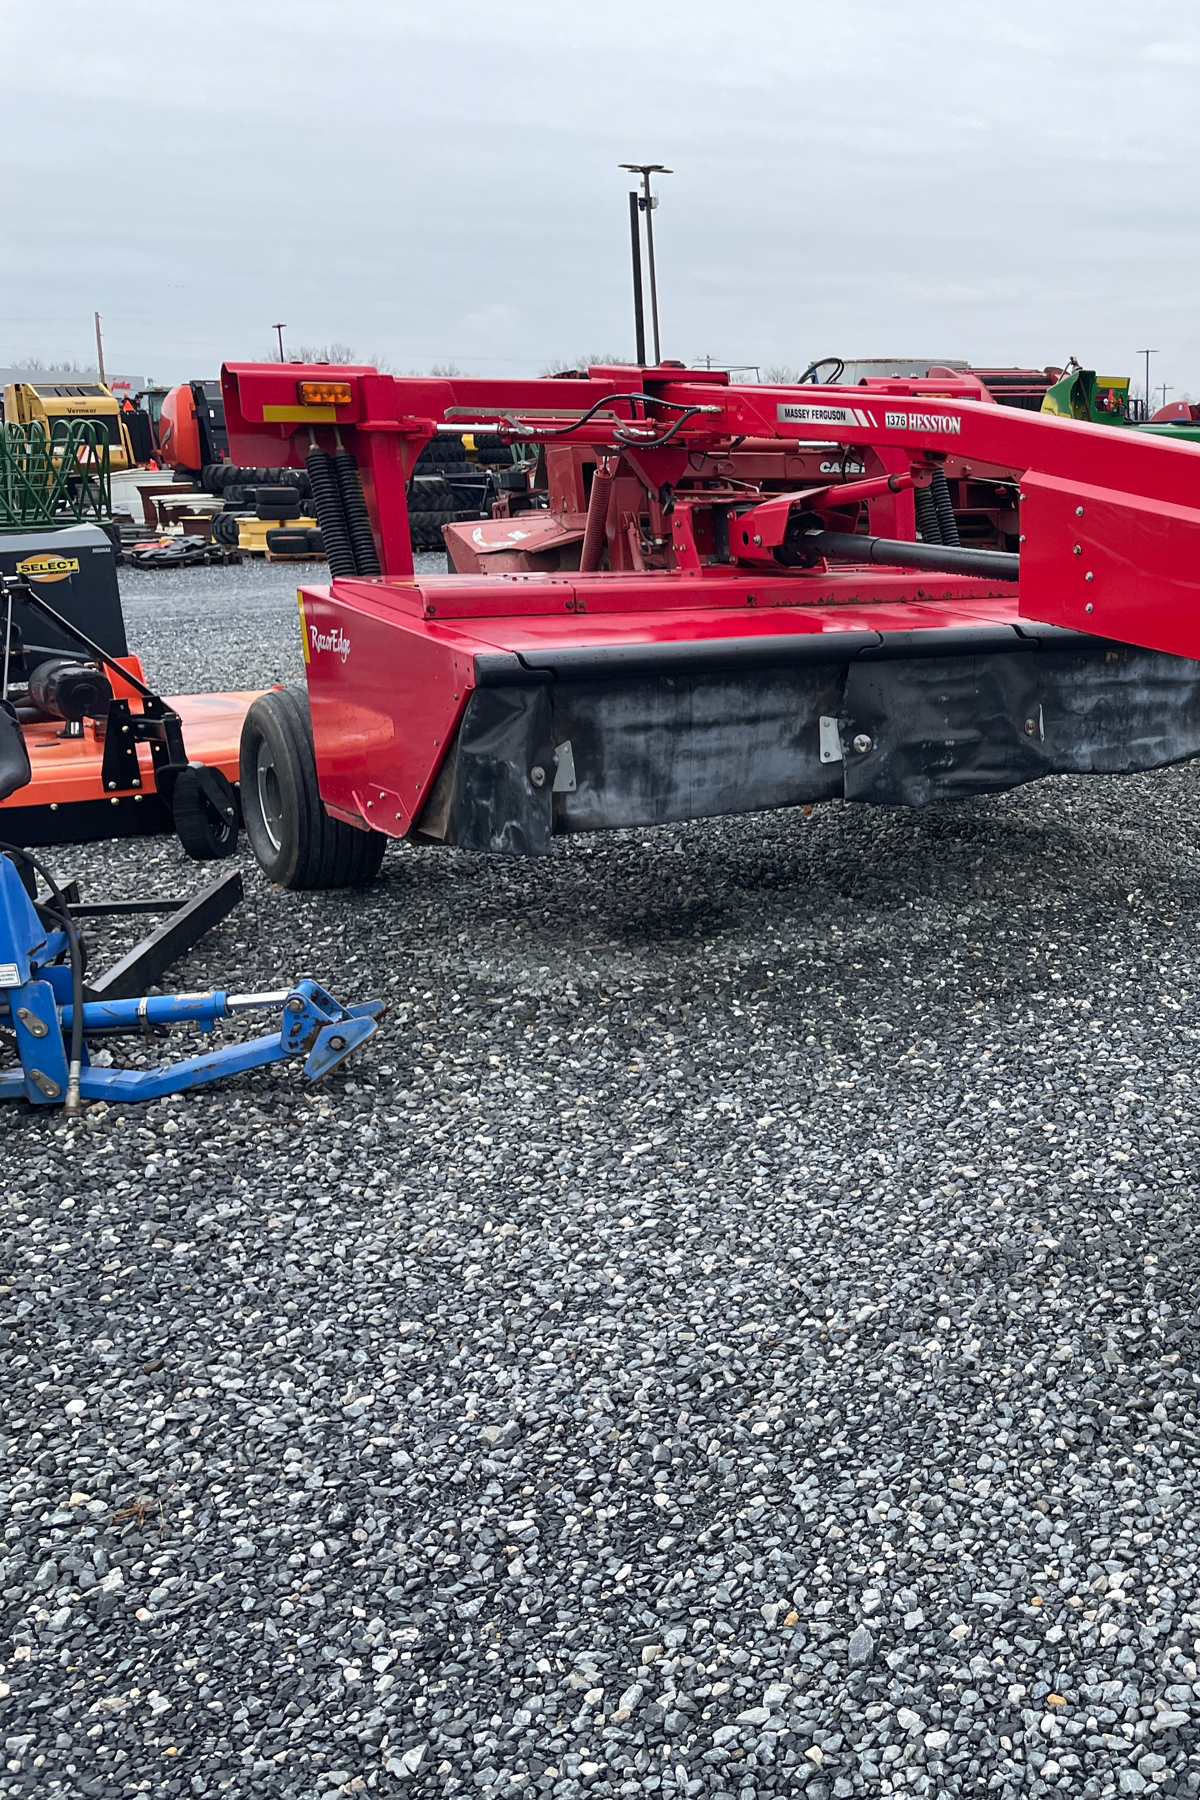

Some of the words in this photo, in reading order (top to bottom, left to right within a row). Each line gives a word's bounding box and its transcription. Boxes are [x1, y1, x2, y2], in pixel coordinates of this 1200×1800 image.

[784, 408, 810, 419] MASSEY
[811, 409, 846, 421] FERGUSON
[886, 415, 906, 426] 1376
[908, 412, 962, 435] HESSTON
[819, 461, 860, 474] CASE
[20, 560, 76, 573] SELECT
[310, 624, 351, 664] RazorEdge
